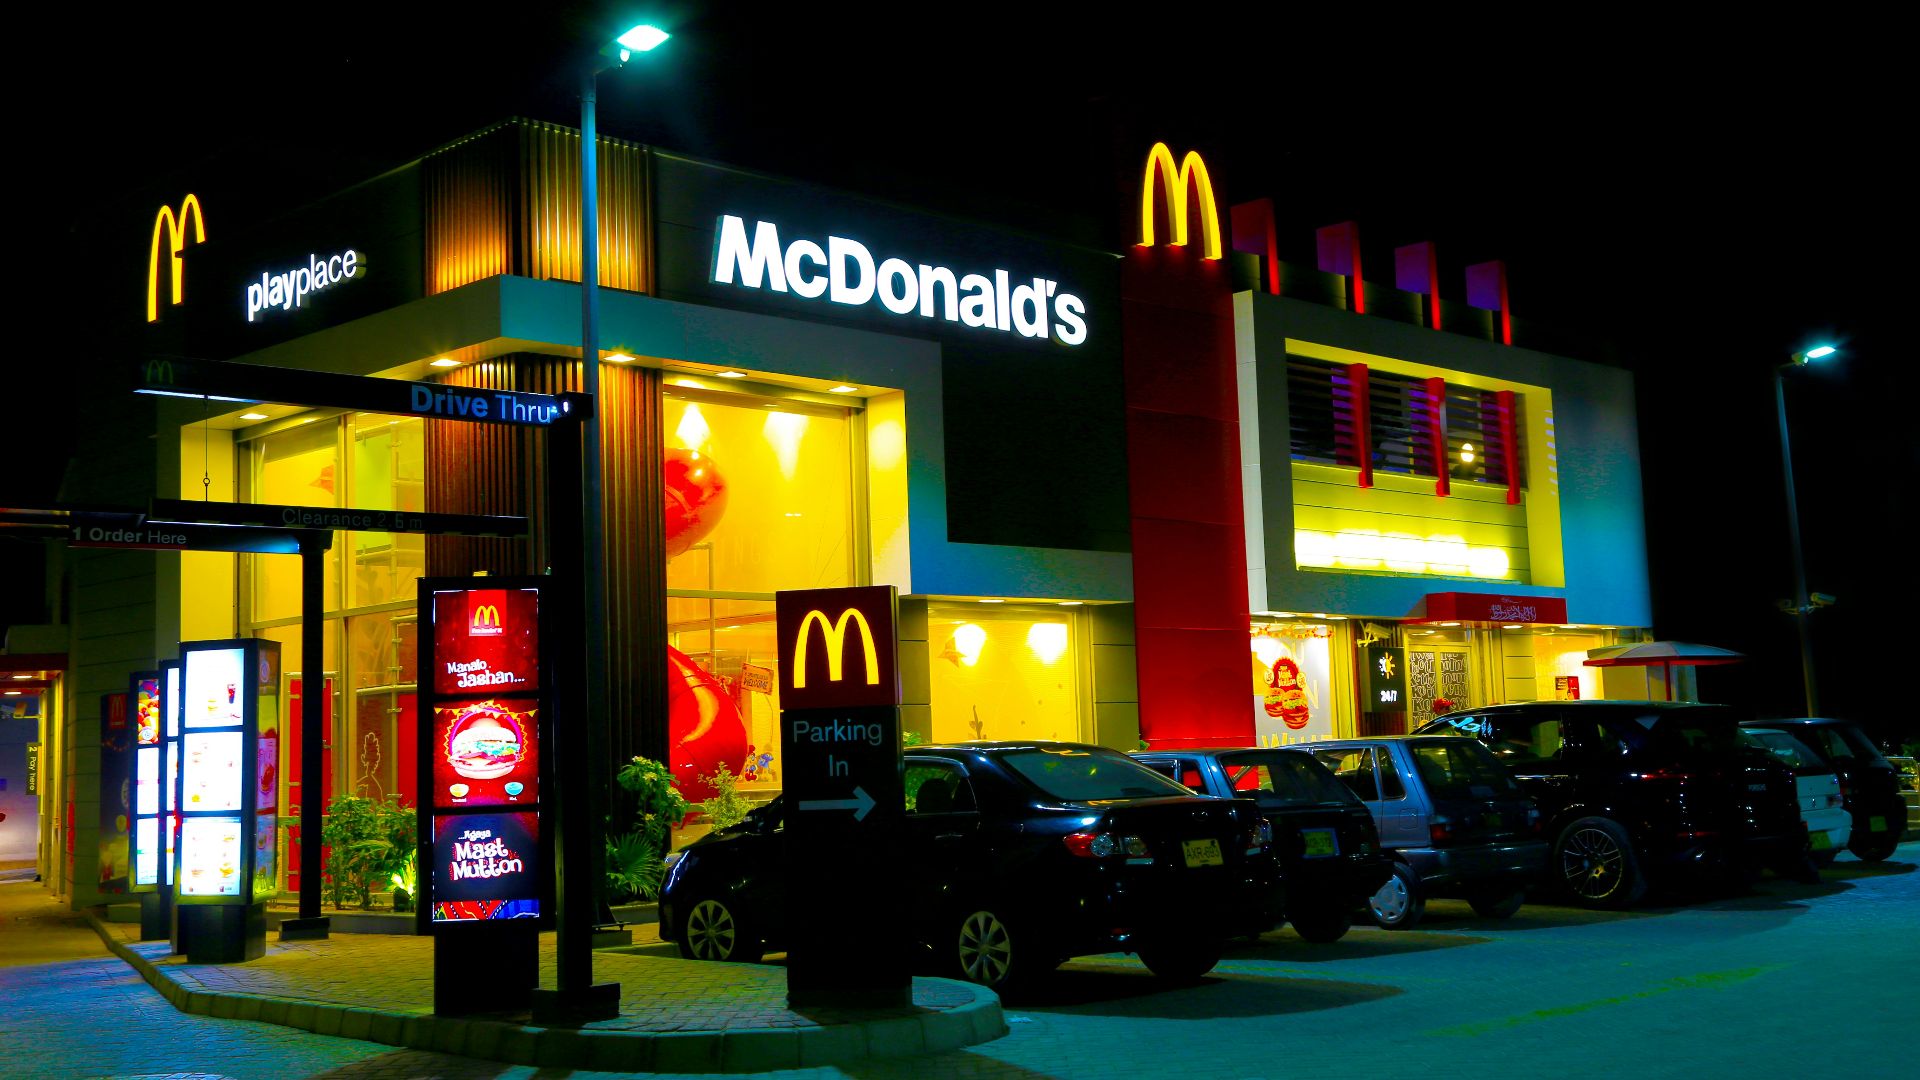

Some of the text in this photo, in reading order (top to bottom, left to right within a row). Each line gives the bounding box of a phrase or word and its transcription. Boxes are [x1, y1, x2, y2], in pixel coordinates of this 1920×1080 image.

[247, 249, 357, 322] playplace
[709, 214, 1088, 346] McDonald's
[411, 384, 551, 424] Drive Thru
[282, 507, 371, 527] Clearance
[72, 526, 188, 545] 1 Order Here
[1380, 689, 1398, 703] 24/7
[793, 718, 883, 747] Parking
[828, 753, 850, 778] In
[454, 837, 509, 862] Mast
[450, 857, 522, 881] Mutton
